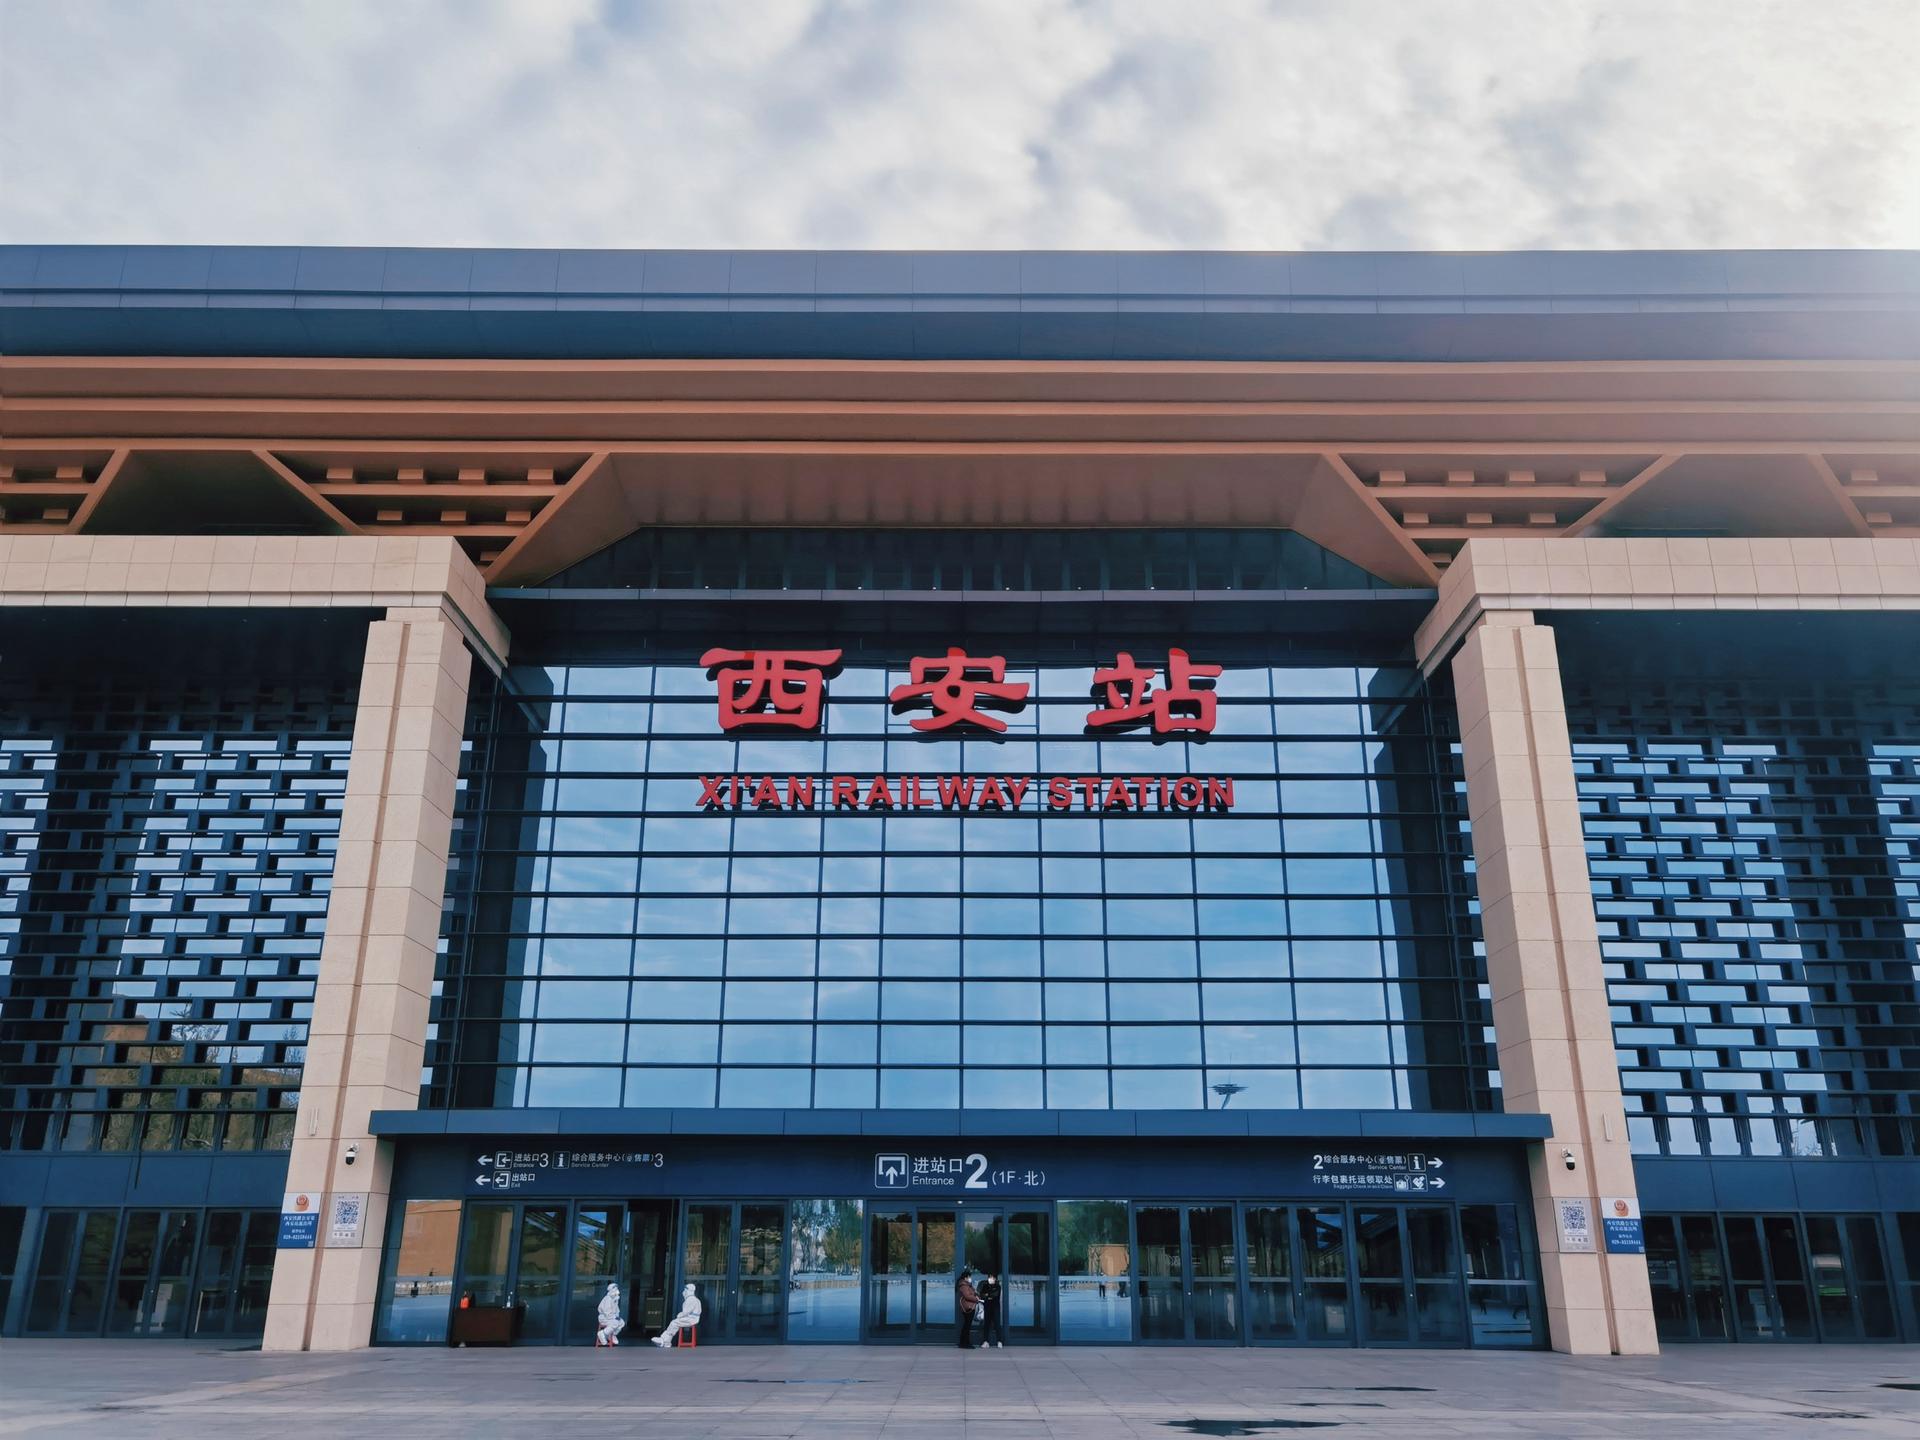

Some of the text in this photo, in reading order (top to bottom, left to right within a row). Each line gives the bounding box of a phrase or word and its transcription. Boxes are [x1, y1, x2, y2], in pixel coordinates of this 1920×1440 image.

[700, 647, 1223, 733] 西安站
[696, 775, 1235, 809] XI'AN RAILWAY STATION
[539, 1153, 550, 1168] 3
[654, 1153, 664, 1168] 3
[1313, 1154, 1324, 1170] 2
[511, 1173, 536, 1182] 出站口
[913, 1157, 963, 1173] 进站口
[964, 1153, 988, 1189] 2
[912, 1176, 955, 1186] Entrance
